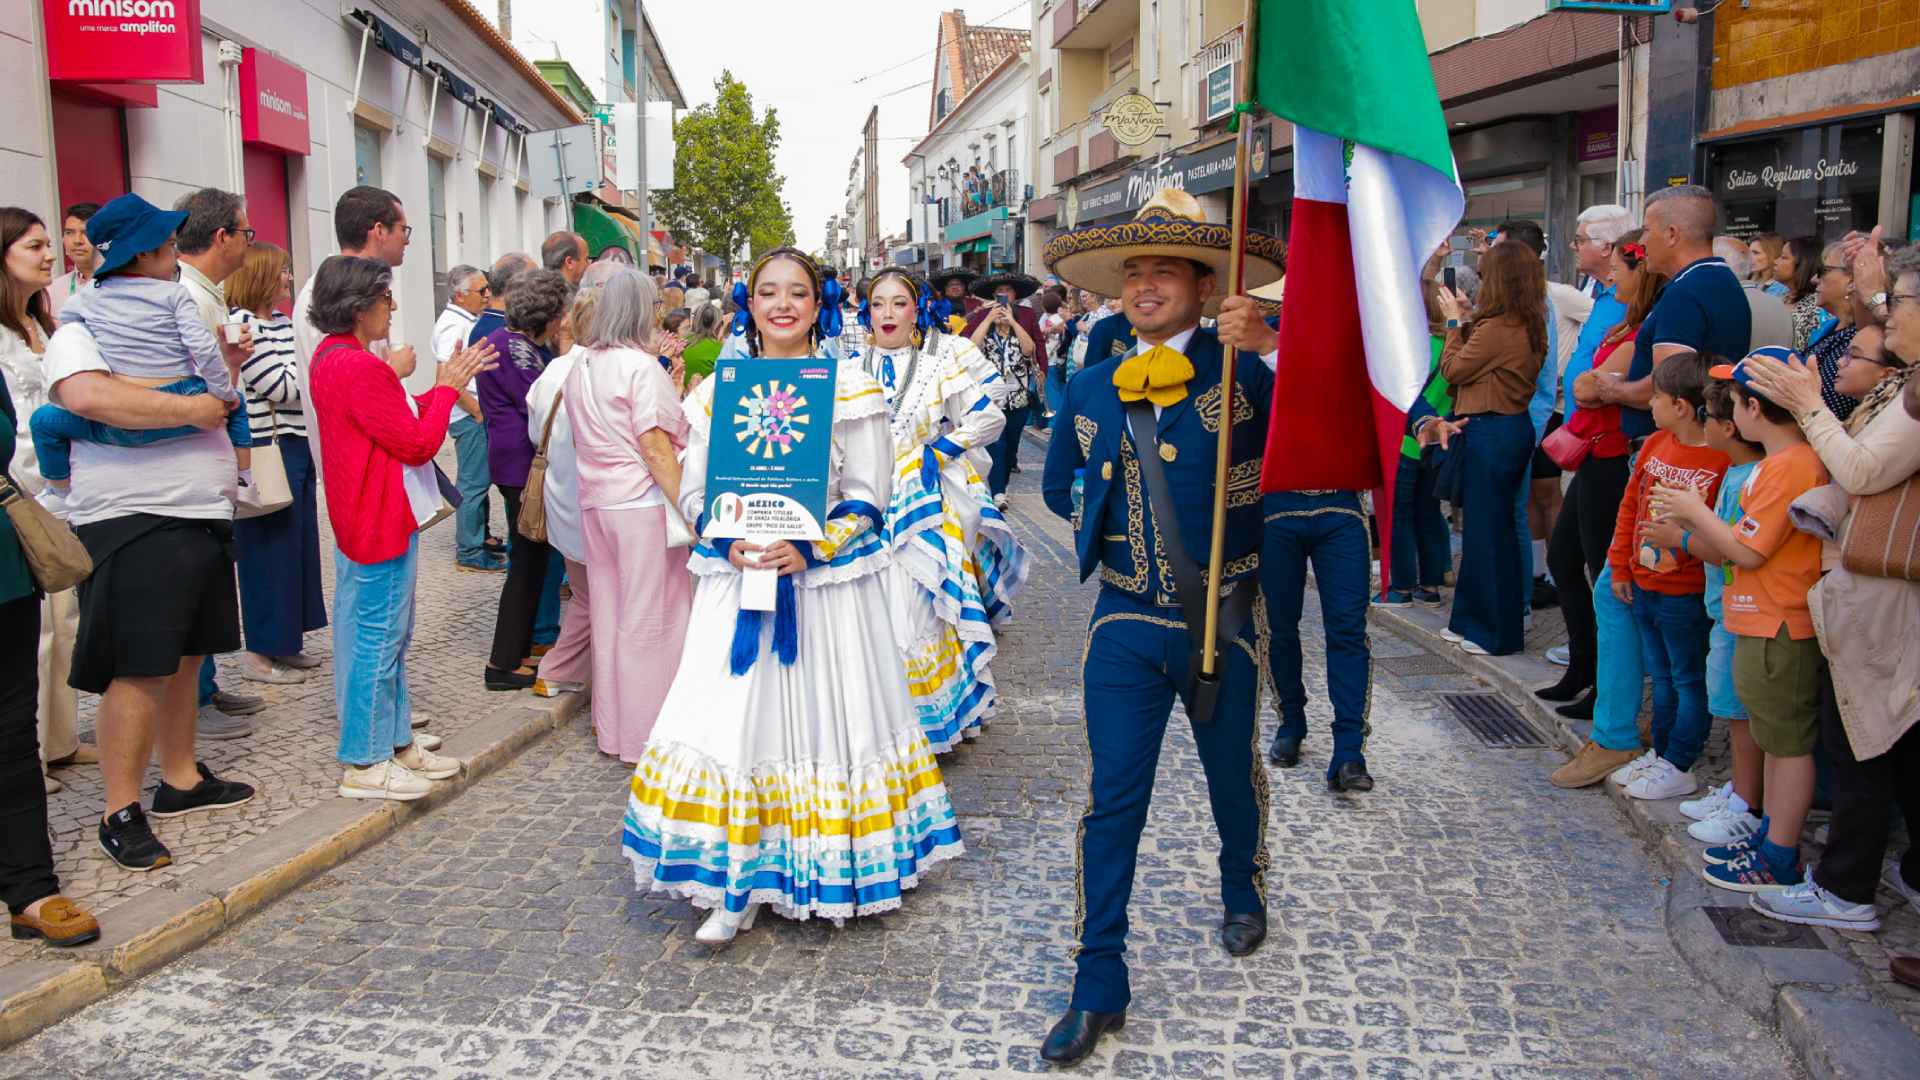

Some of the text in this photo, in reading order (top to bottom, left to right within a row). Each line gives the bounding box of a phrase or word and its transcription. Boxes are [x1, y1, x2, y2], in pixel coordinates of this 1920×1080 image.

[68, 0, 176, 18] minisom
[119, 21, 176, 36] amplifon
[260, 88, 292, 115] minisom
[1187, 155, 1237, 181] PASTELARIA PADA
[1727, 158, 1858, 191] Salão Regilane Santos
